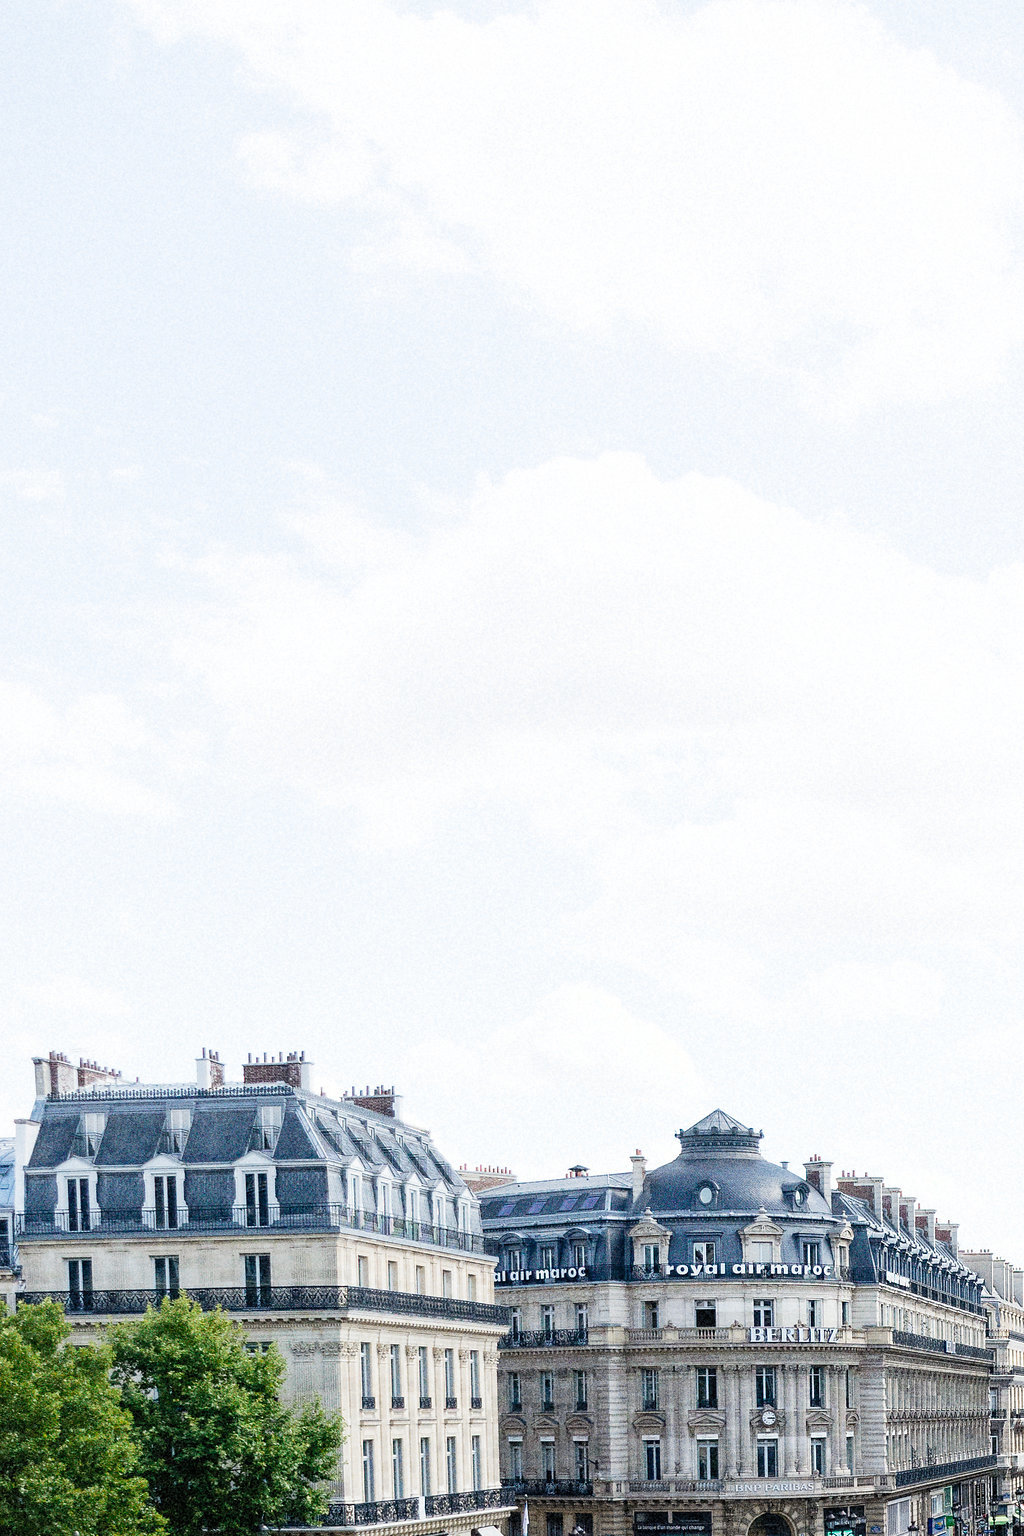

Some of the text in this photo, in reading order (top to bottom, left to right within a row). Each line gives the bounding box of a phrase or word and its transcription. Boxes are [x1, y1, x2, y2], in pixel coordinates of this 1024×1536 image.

[511, 1266, 532, 1282] air
[535, 1265, 586, 1280] maroc
[665, 1262, 832, 1278] royal air maroc
[750, 1326, 839, 1344] BERLITZ
[735, 1481, 815, 1492] BNP PARIBAS
